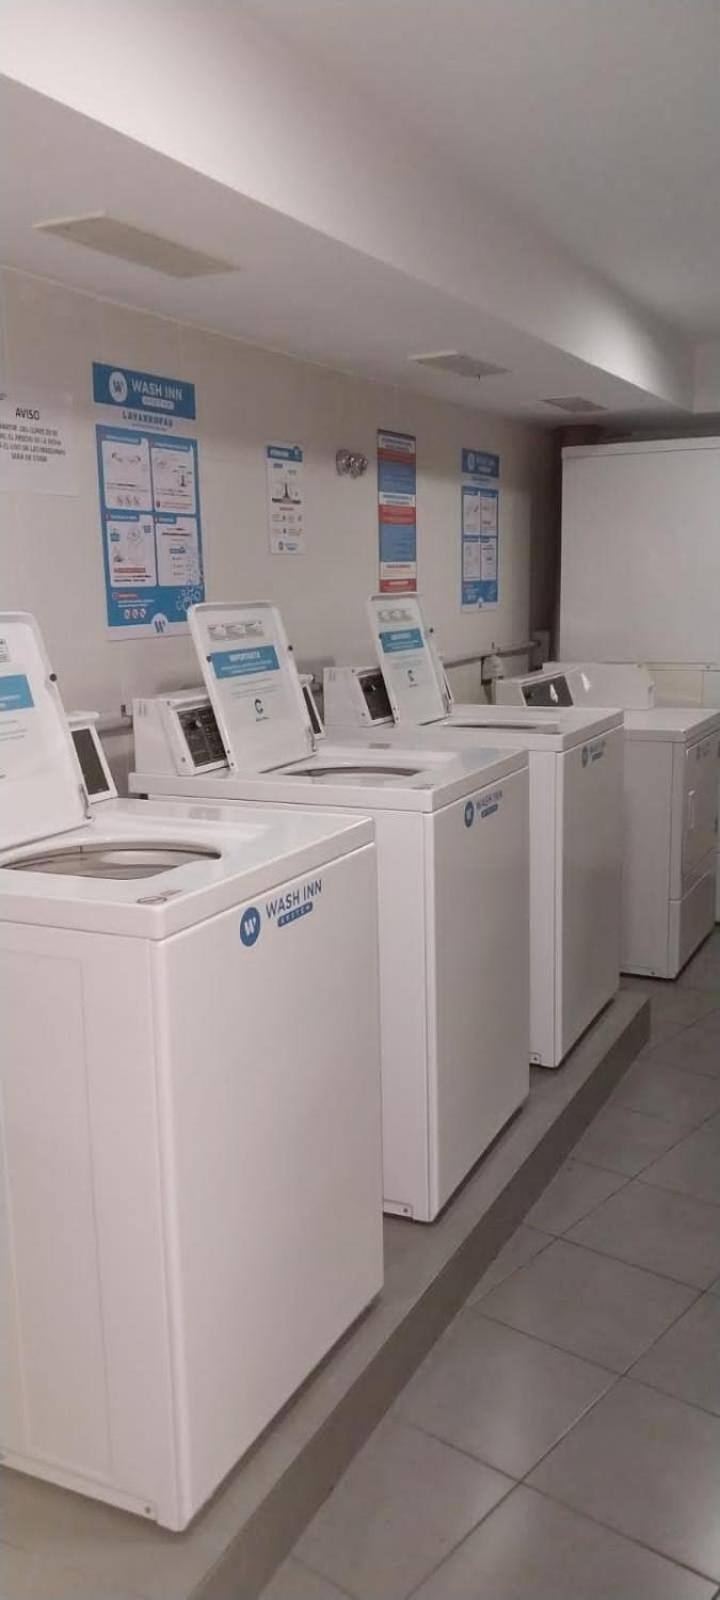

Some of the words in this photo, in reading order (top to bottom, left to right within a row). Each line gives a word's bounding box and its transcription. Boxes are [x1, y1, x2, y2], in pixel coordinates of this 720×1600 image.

[131, 379, 162, 397] WASH
[165, 386, 183, 401] INN
[15, 407, 40, 421] AVISO
[265, 890, 300, 919] WASH
[303, 879, 322, 901] INN
